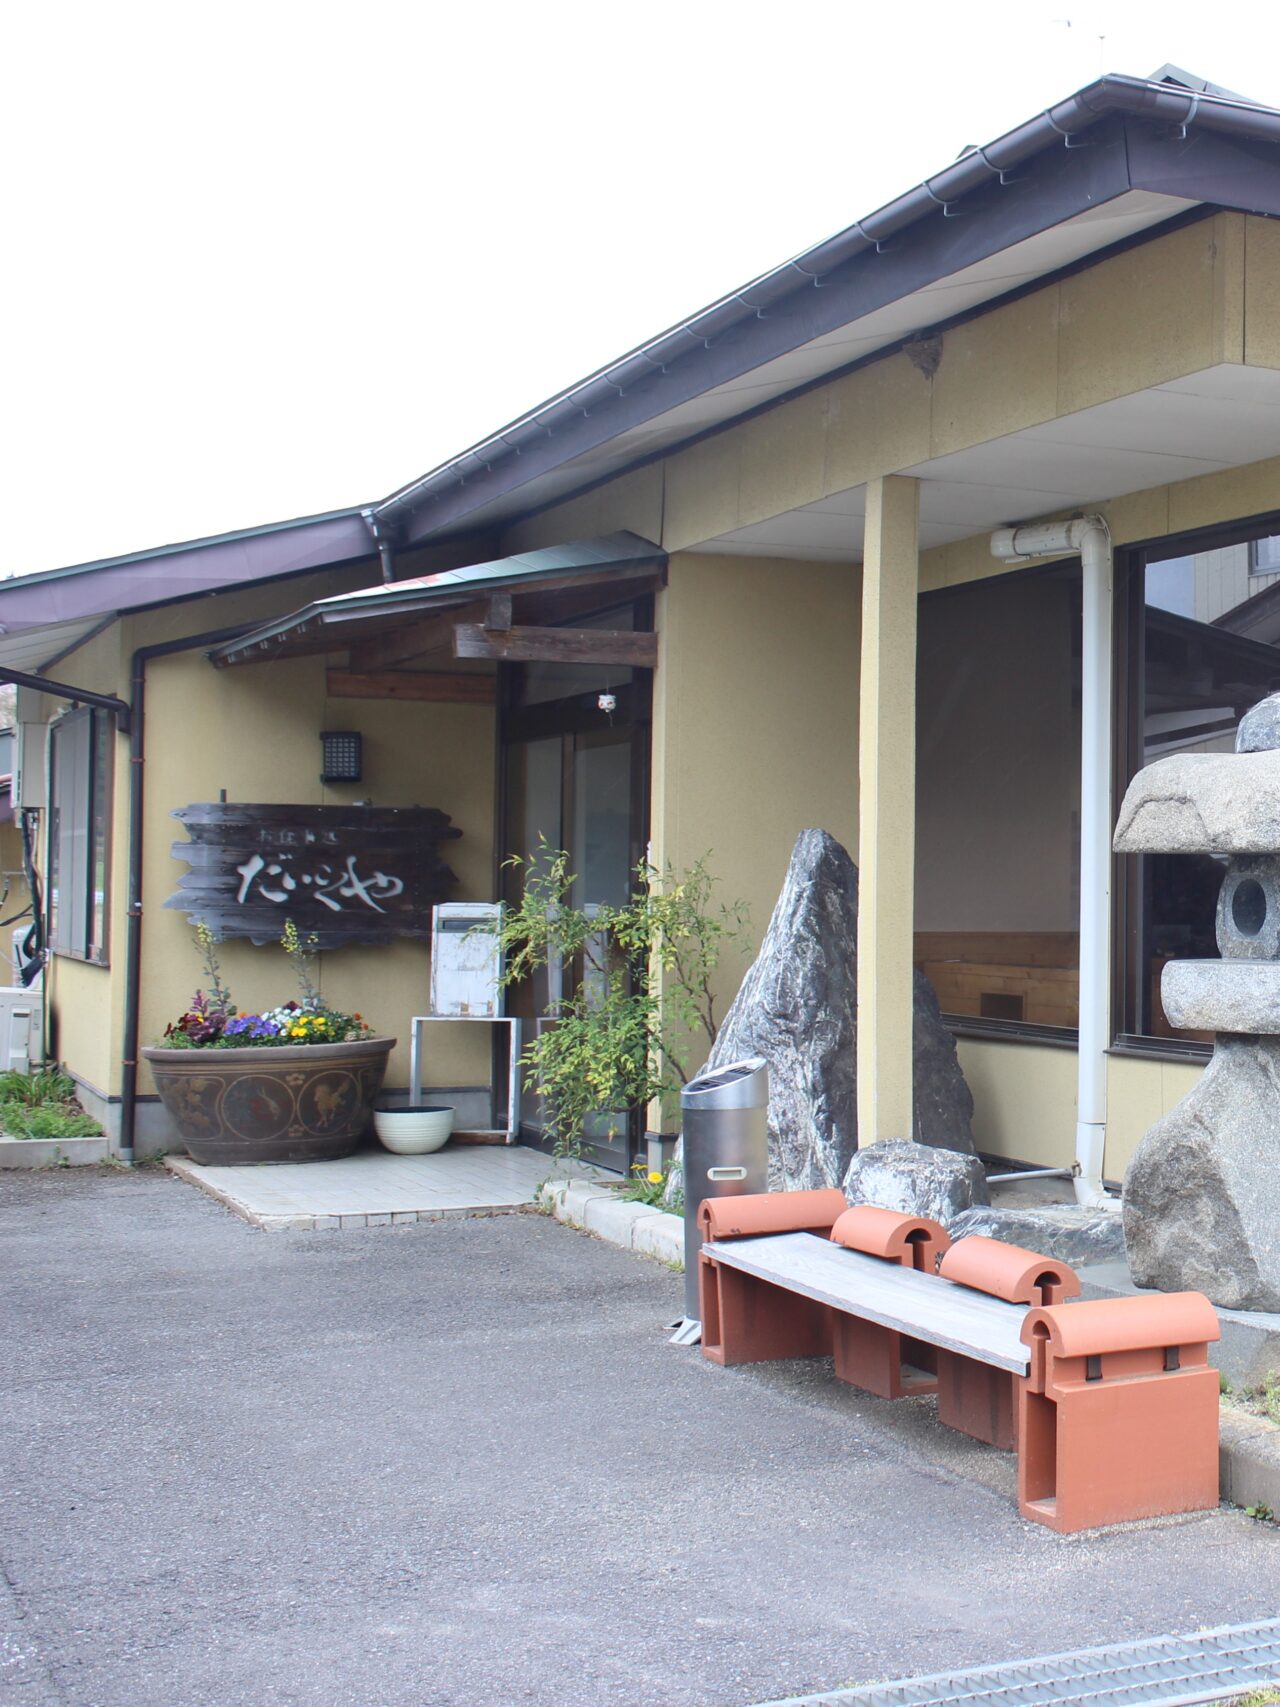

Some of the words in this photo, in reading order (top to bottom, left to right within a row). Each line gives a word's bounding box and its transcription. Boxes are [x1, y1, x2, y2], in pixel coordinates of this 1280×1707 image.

[236, 853, 404, 914] だいこくや
